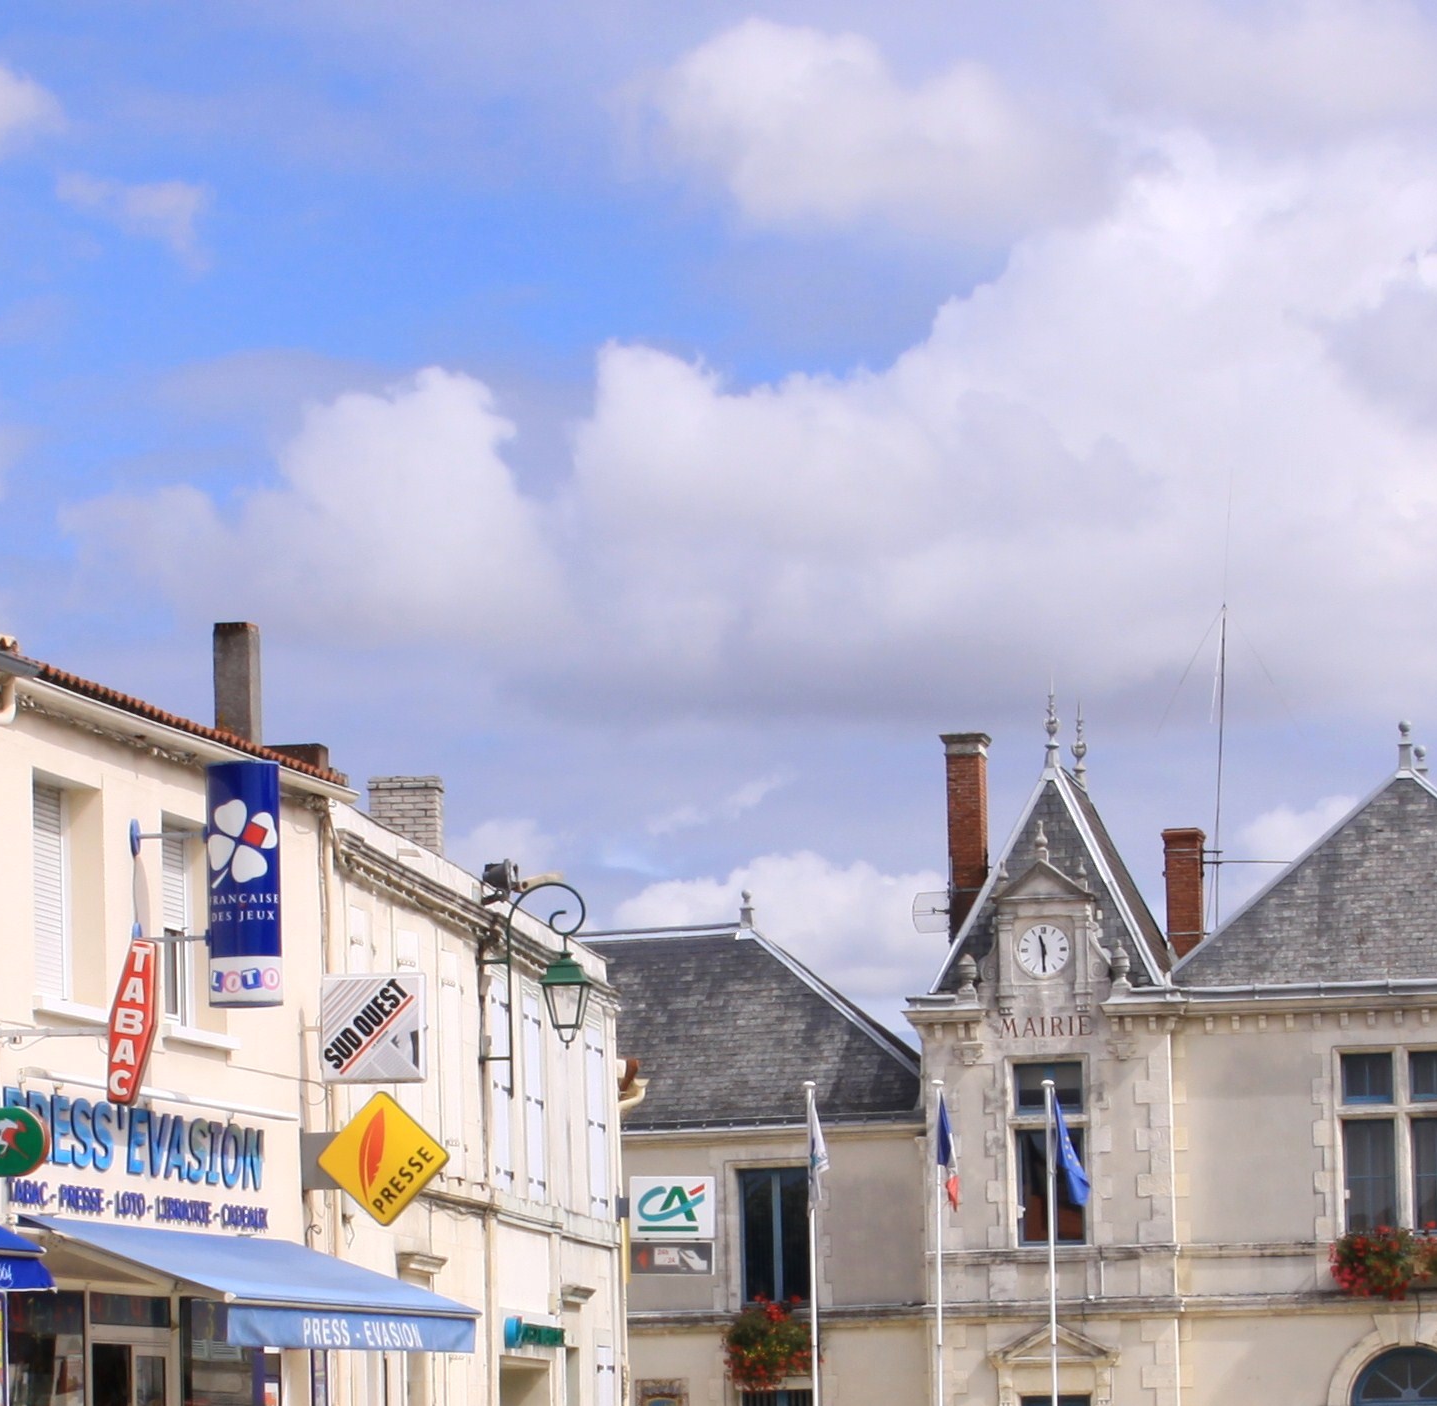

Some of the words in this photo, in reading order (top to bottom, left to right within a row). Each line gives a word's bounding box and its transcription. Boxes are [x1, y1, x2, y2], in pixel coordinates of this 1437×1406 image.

[211, 911, 232, 922] DES
[238, 910, 275, 922] JEUX
[211, 967, 280, 993] LOTO
[109, 945, 151, 1096] TABAC
[324, 1027, 363, 1069] SUD
[353, 978, 408, 1037] OUEST
[999, 1015, 1093, 1039] MAIRIE
[372, 1145, 435, 1215] PRESSE
[6, 1176, 48, 1207] TABAC
[58, 1184, 105, 1214] PRESSE
[114, 1191, 145, 1218] LOTO
[155, 1196, 212, 1226] LIBRAIRIE
[221, 1203, 269, 1231] CADEAUX
[303, 1318, 351, 1346] PRESS
[363, 1321, 423, 1348] EVASION
